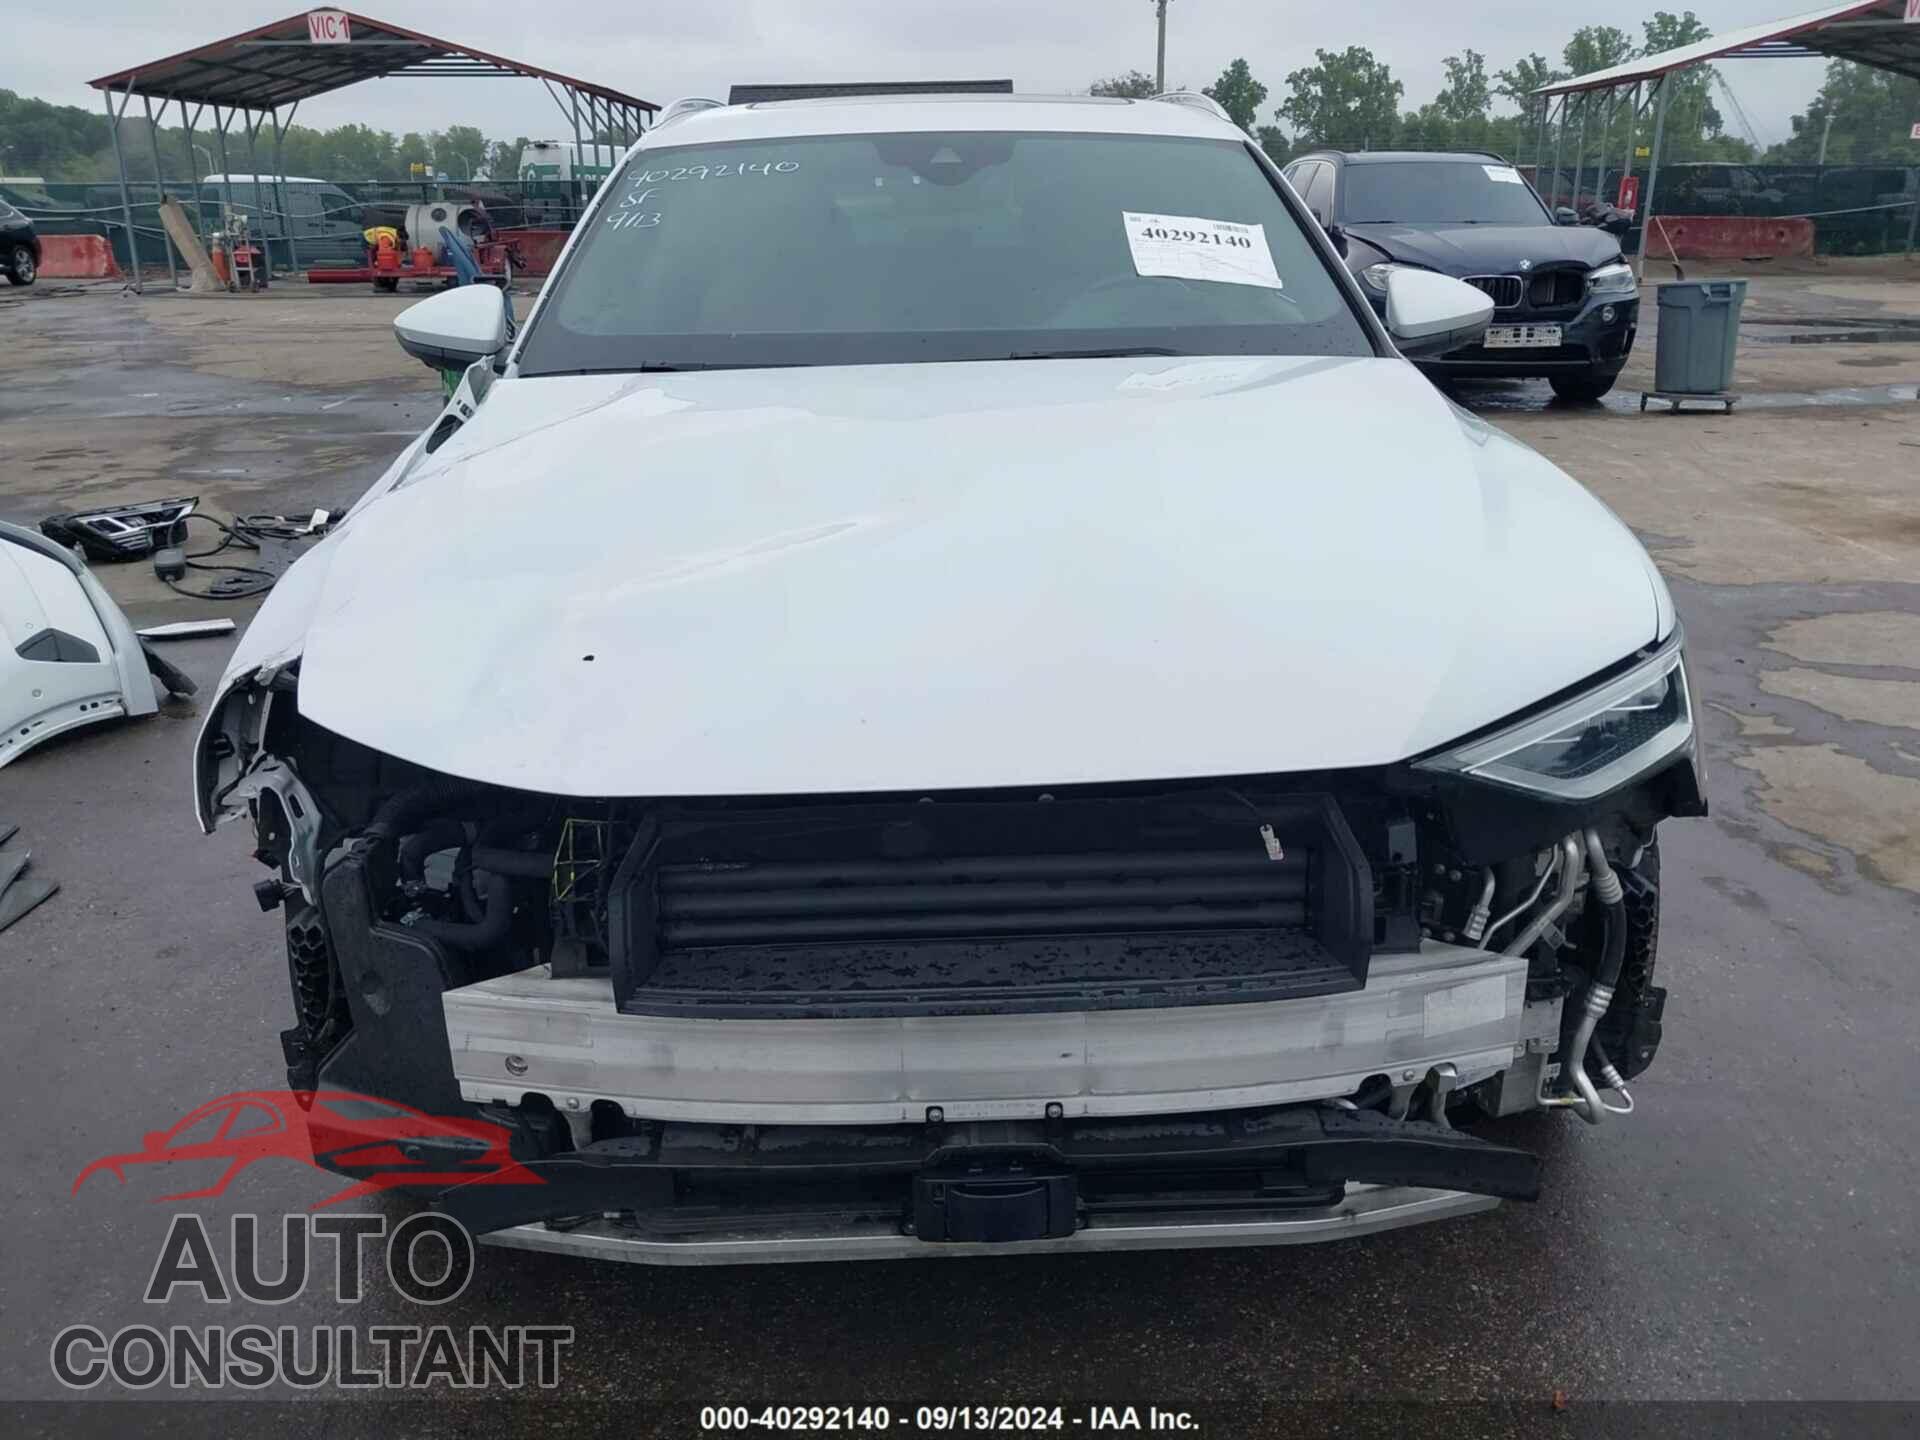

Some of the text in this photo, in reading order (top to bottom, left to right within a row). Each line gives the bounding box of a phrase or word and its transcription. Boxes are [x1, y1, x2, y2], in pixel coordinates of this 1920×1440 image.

[310, 15, 349, 39] VIC 1
[627, 161, 800, 187] 40292140
[1141, 227, 1251, 249] 40292140
